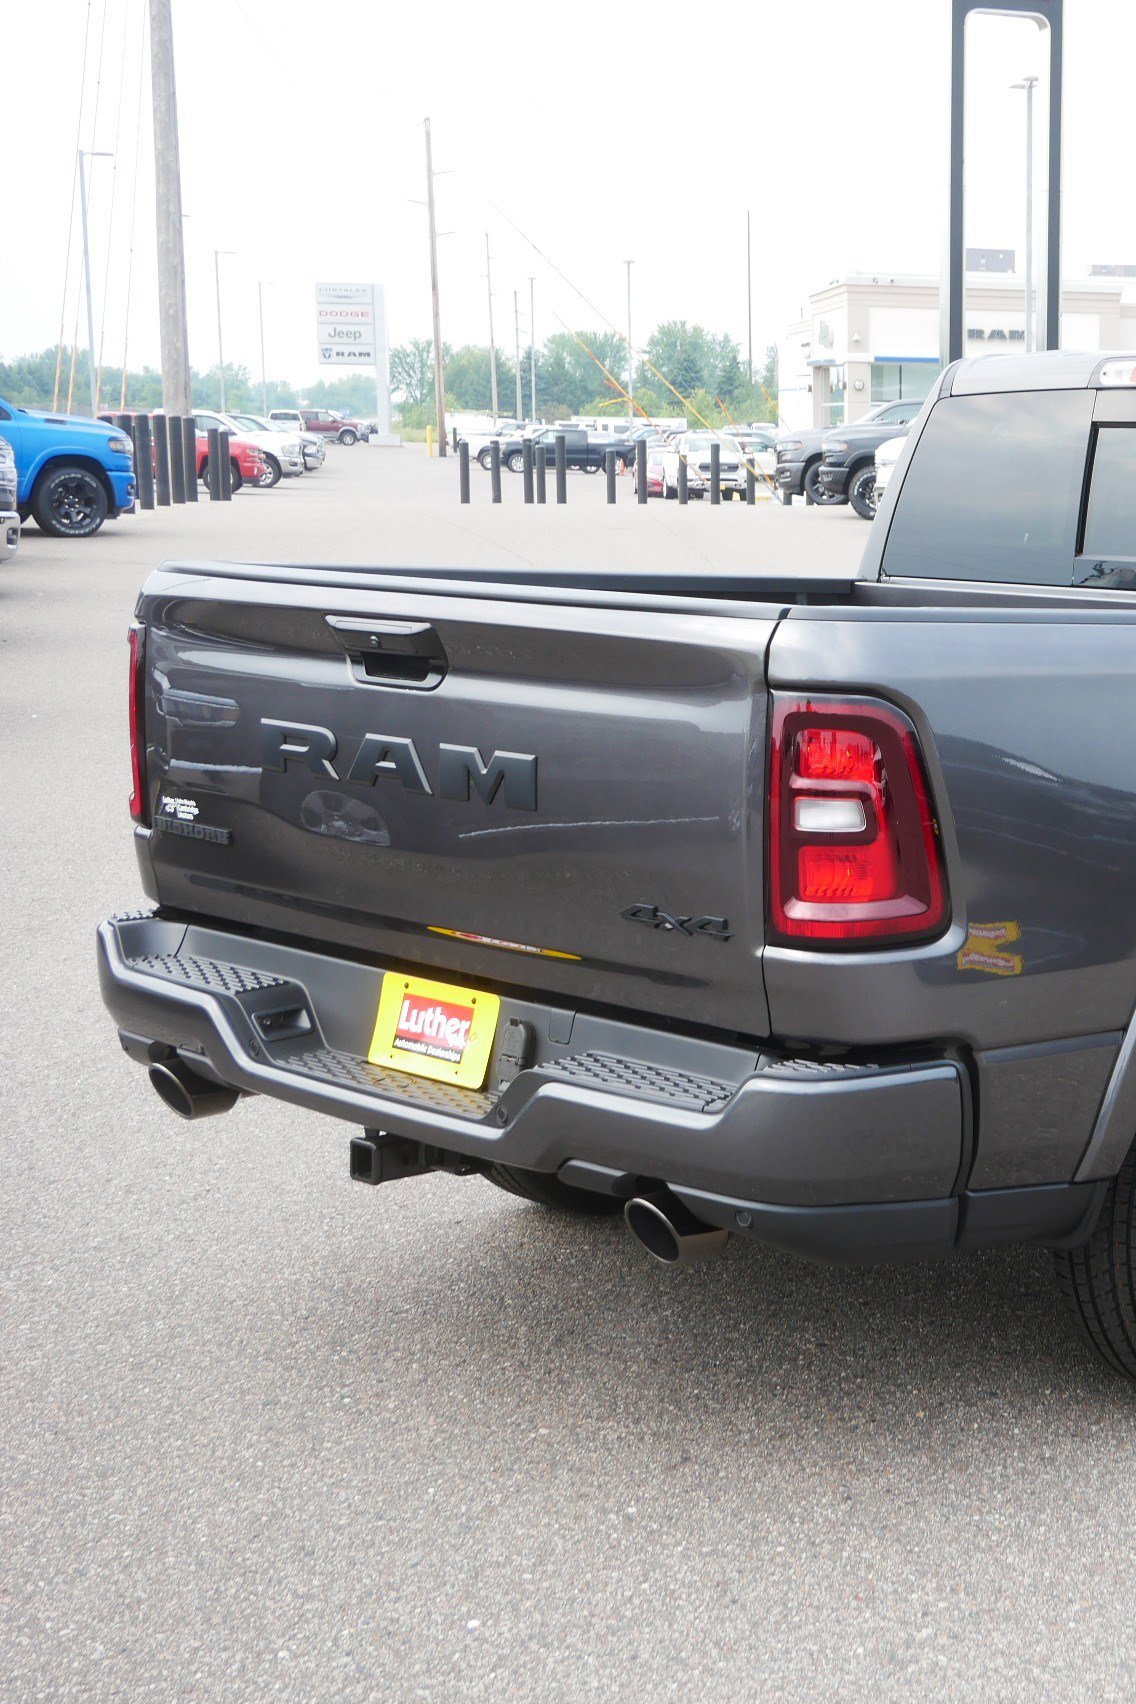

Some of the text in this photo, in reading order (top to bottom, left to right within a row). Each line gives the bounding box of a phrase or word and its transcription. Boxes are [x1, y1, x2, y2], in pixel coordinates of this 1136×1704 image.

[319, 310, 370, 318] DODGE
[327, 327, 362, 341] Jeep
[260, 717, 538, 812] RAM
[398, 999, 471, 1048] Luther
